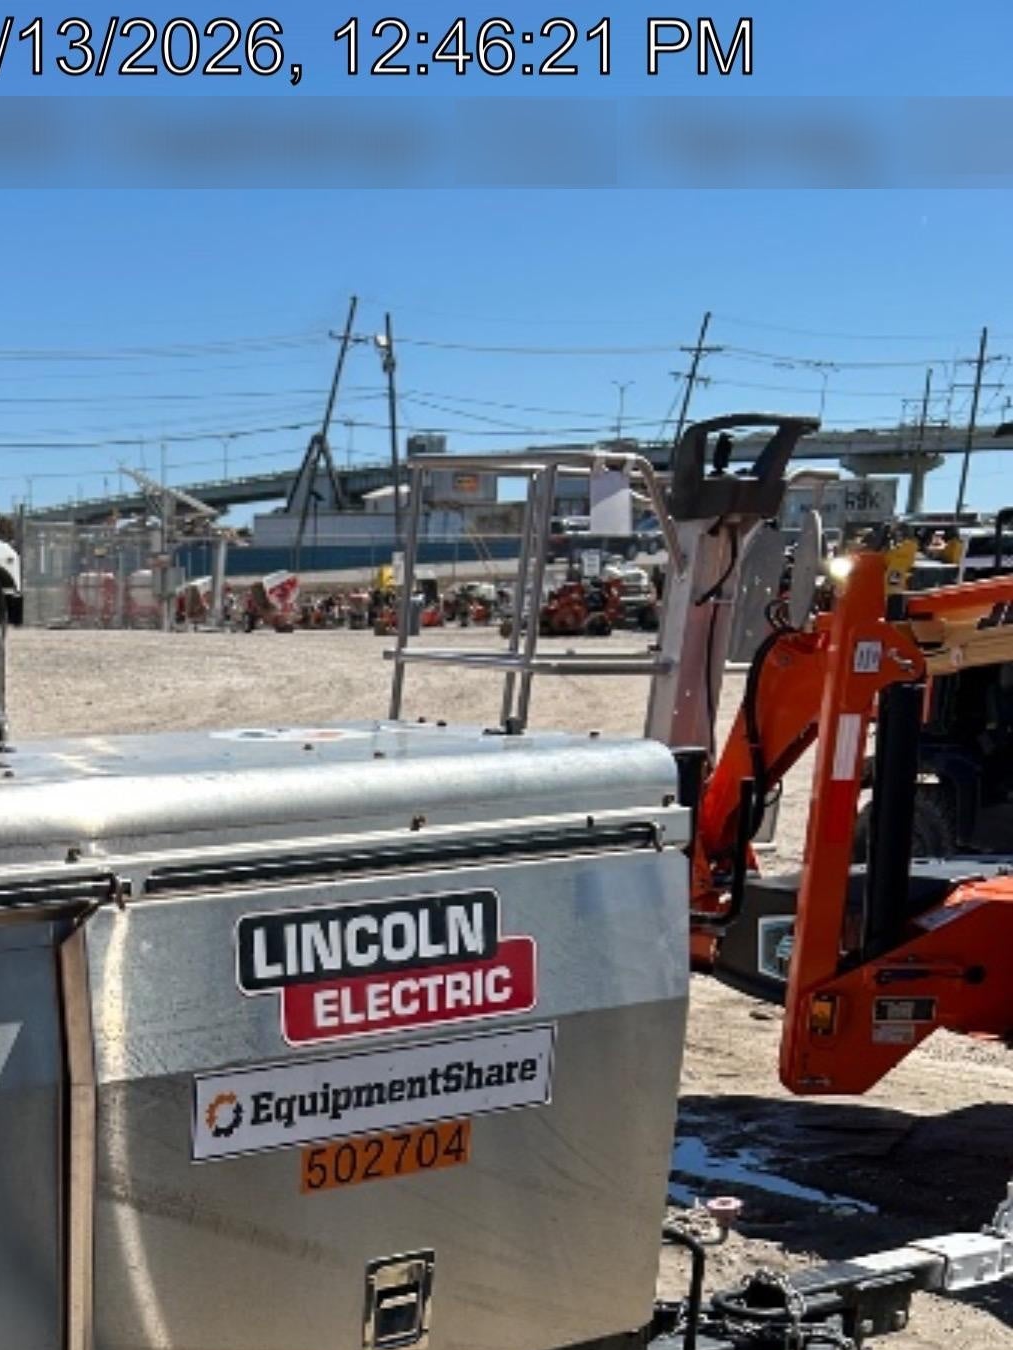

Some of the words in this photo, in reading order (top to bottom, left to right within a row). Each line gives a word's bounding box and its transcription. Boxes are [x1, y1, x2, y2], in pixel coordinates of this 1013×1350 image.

[252, 902, 485, 979] LINCOLN
[313, 966, 513, 1028] ELECTRIC
[250, 1054, 537, 1129] EquipmentShare
[306, 1124, 465, 1190] 502704
